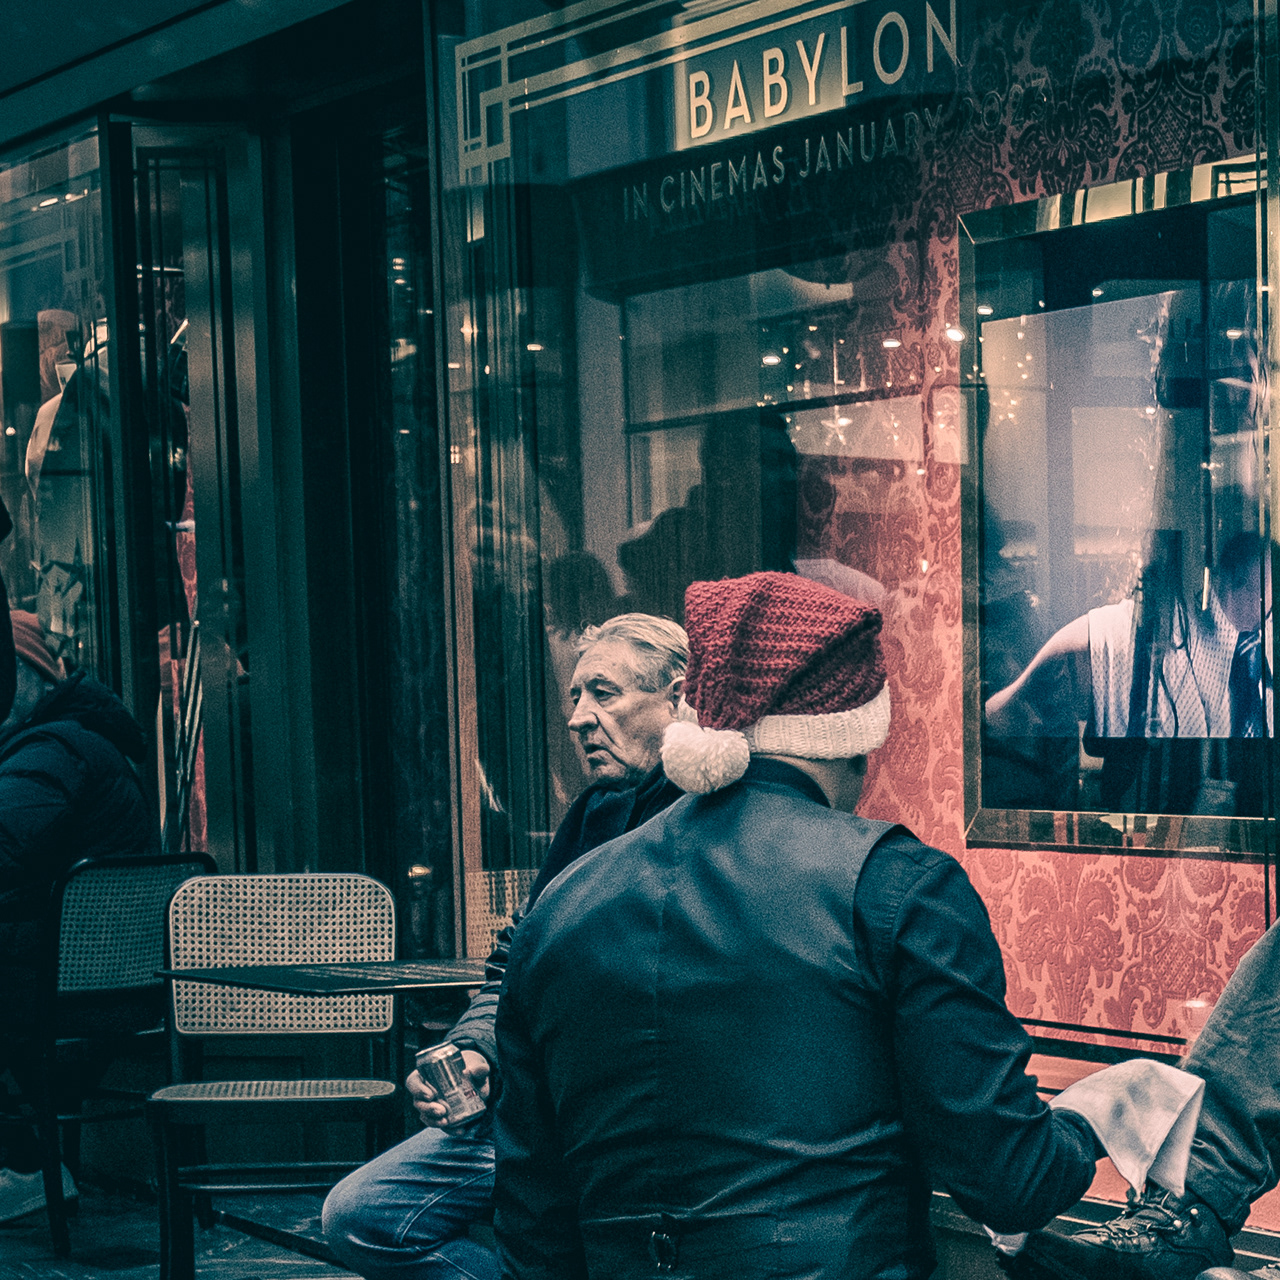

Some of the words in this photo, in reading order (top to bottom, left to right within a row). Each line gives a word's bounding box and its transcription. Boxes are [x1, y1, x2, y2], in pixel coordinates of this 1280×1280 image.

[689, 0, 962, 140] BABYLON
[622, 186, 650, 223] IN
[659, 145, 787, 214] CINEMAS
[798, 105, 944, 178] JANUARY
